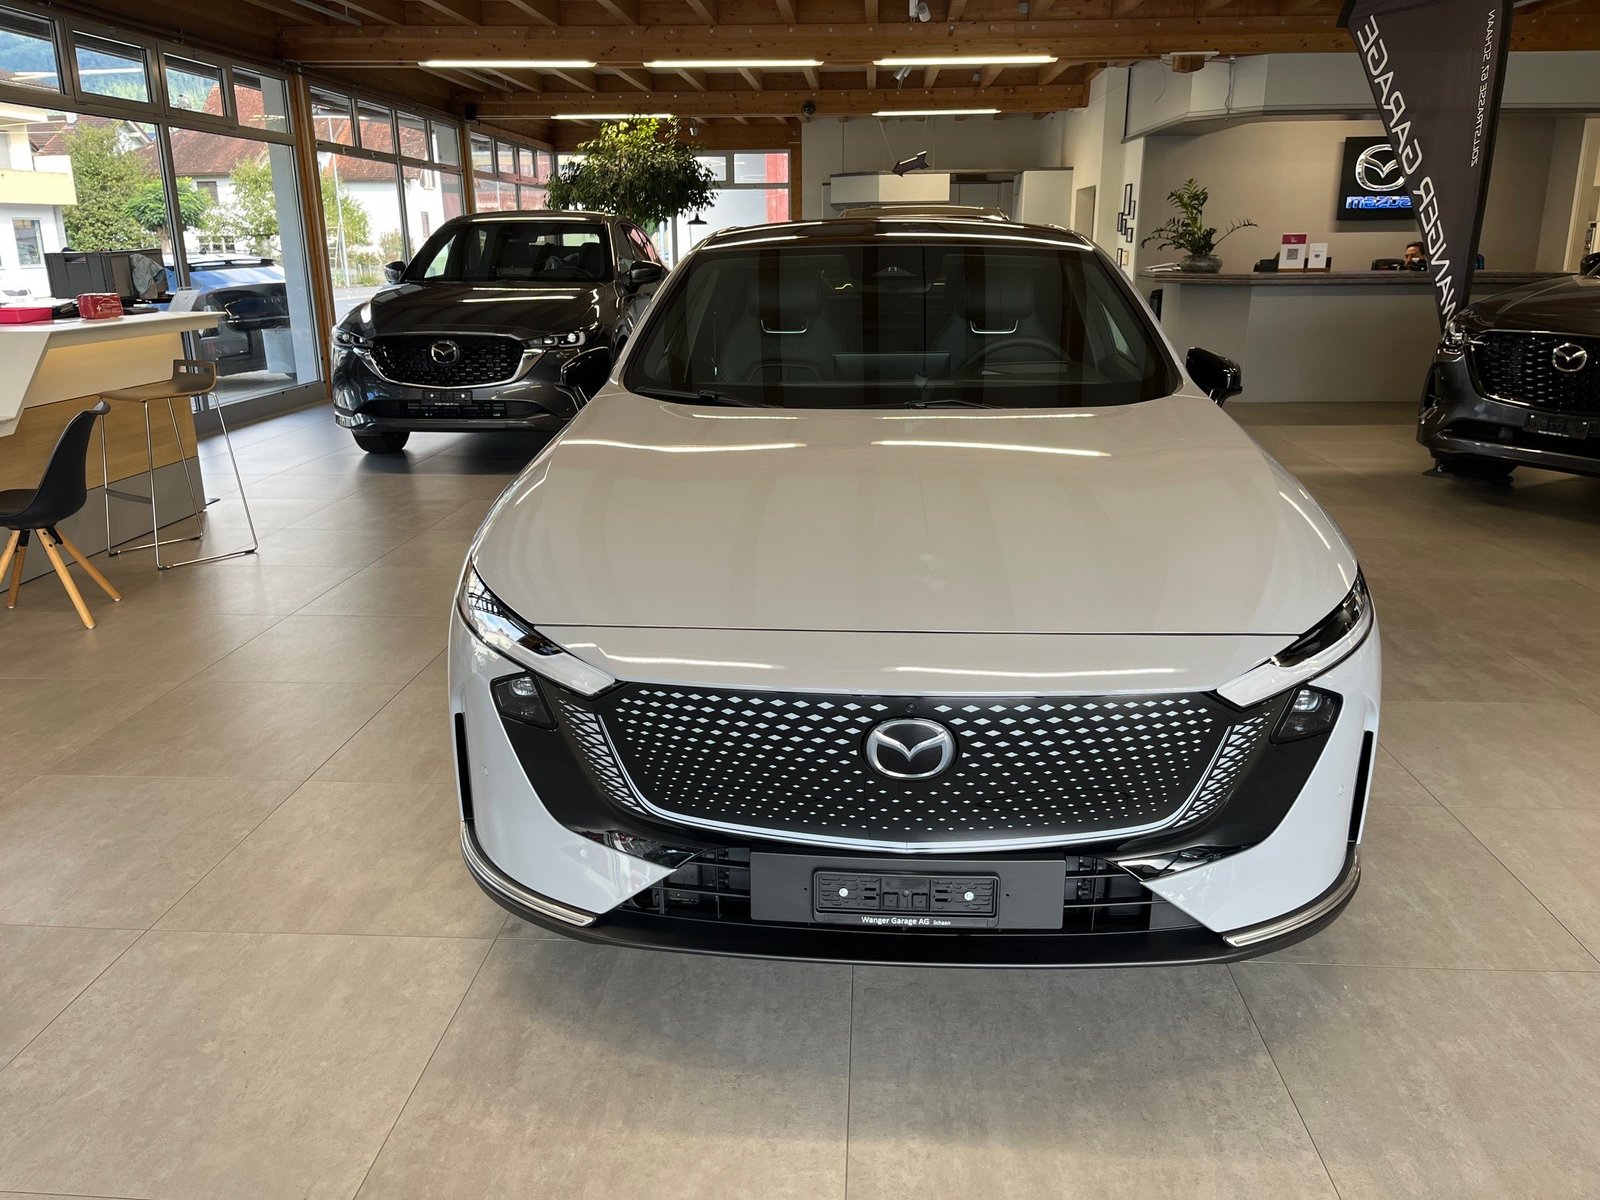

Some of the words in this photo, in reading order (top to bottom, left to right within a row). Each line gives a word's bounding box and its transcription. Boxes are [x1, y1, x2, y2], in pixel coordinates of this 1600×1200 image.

[1345, 195, 1413, 209] mazda
[861, 916, 889, 925] Wanger
[891, 917, 917, 926] Garage
